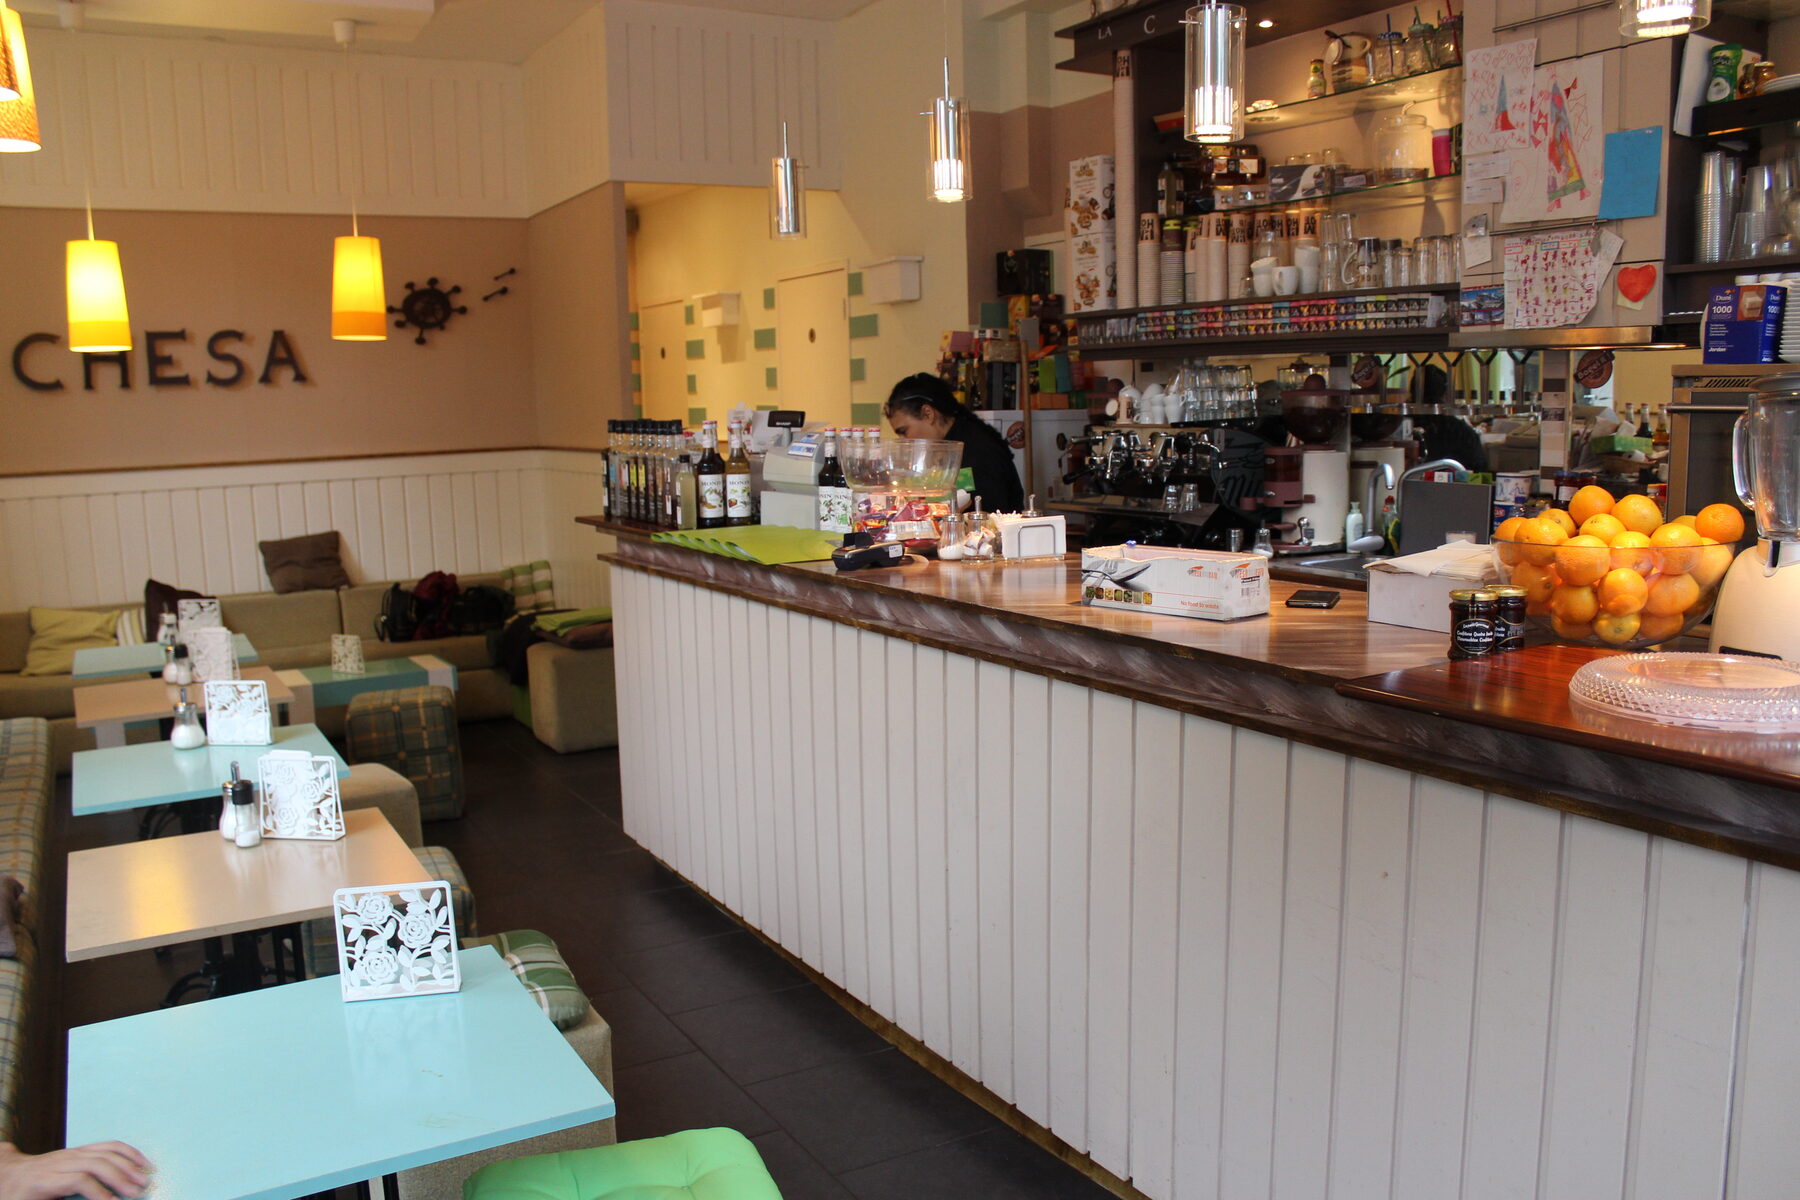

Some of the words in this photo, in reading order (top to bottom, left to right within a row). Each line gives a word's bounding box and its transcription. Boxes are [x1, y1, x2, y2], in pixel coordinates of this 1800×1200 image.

[1098, 26, 1113, 40] LA
[1712, 305, 1733, 314] 1000
[11, 329, 309, 391] CHESA
